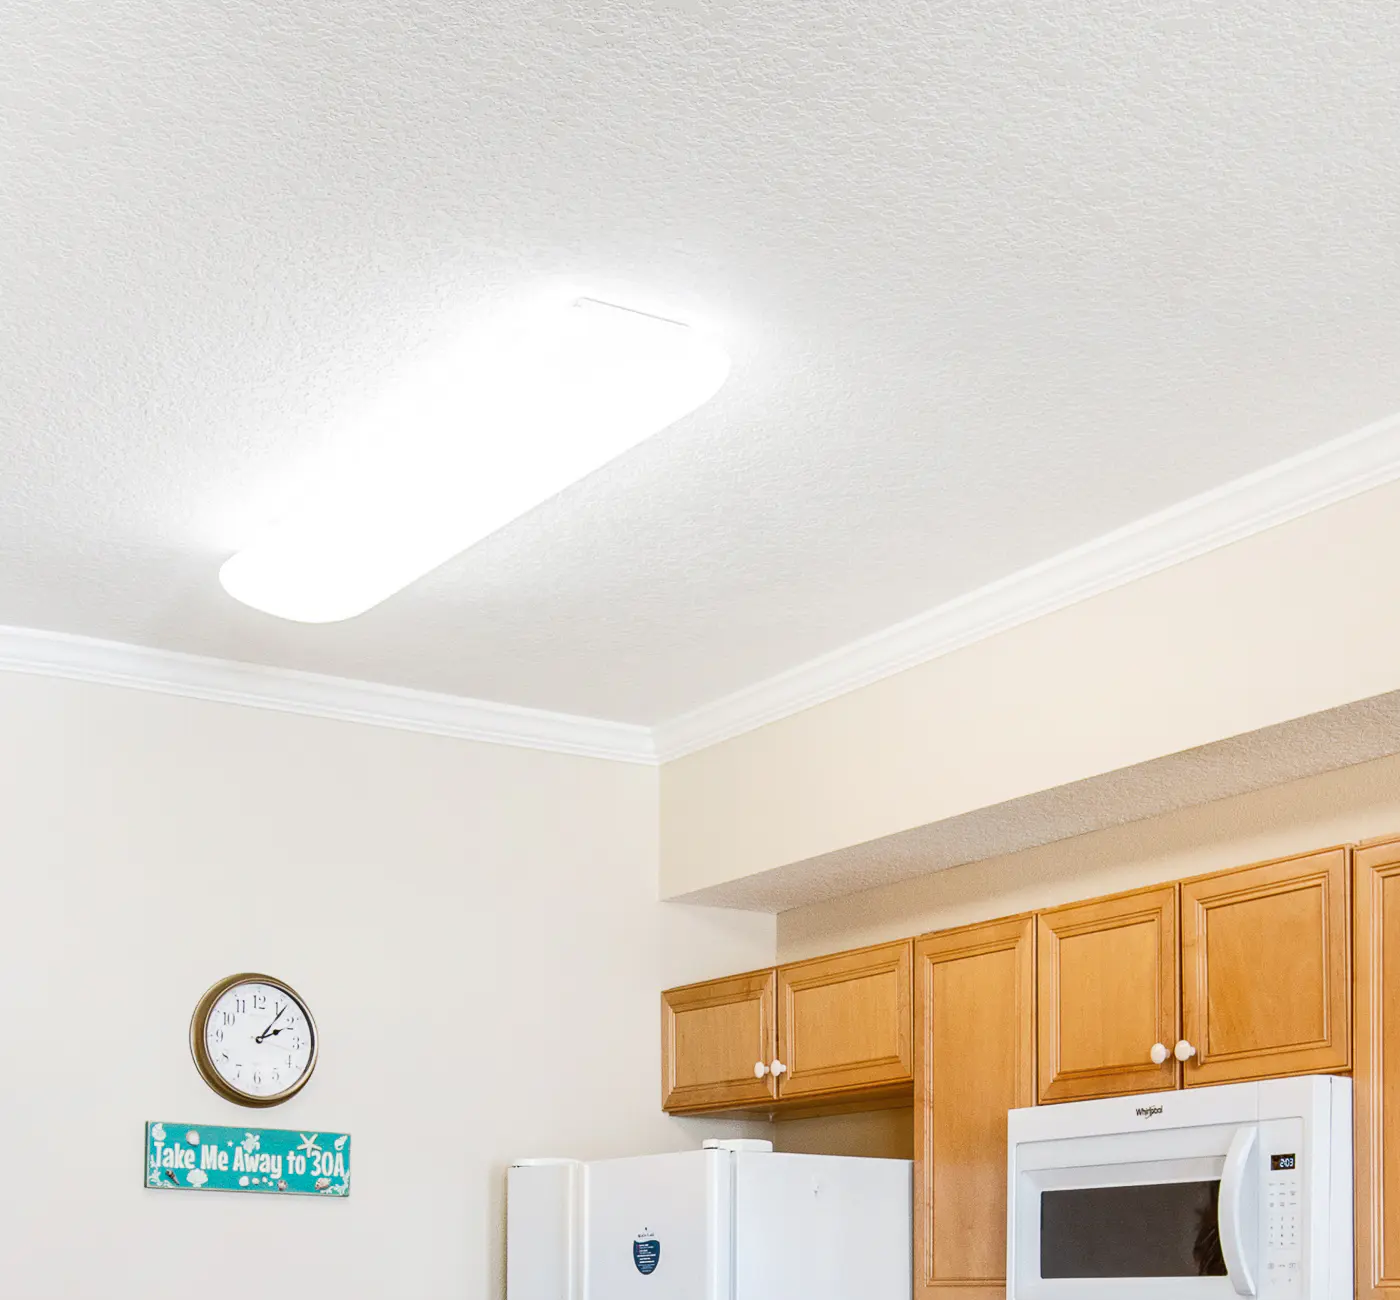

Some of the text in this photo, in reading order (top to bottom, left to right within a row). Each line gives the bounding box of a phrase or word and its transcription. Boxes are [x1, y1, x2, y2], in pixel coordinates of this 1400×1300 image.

[236, 999, 245, 1013] 11
[253, 994, 266, 1009] 12
[223, 1011, 235, 1026] 10
[286, 1017, 294, 1030] 2
[216, 1029, 223, 1042] 9
[292, 1036, 299, 1049] 3
[285, 1055, 292, 1068] 4
[235, 1064, 242, 1078] 7
[253, 1070, 261, 1084] 6
[271, 1067, 279, 1081] 5
[1136, 1104, 1163, 1119] Whirlpool
[153, 1141, 345, 1179] Take Me Away to 30A
